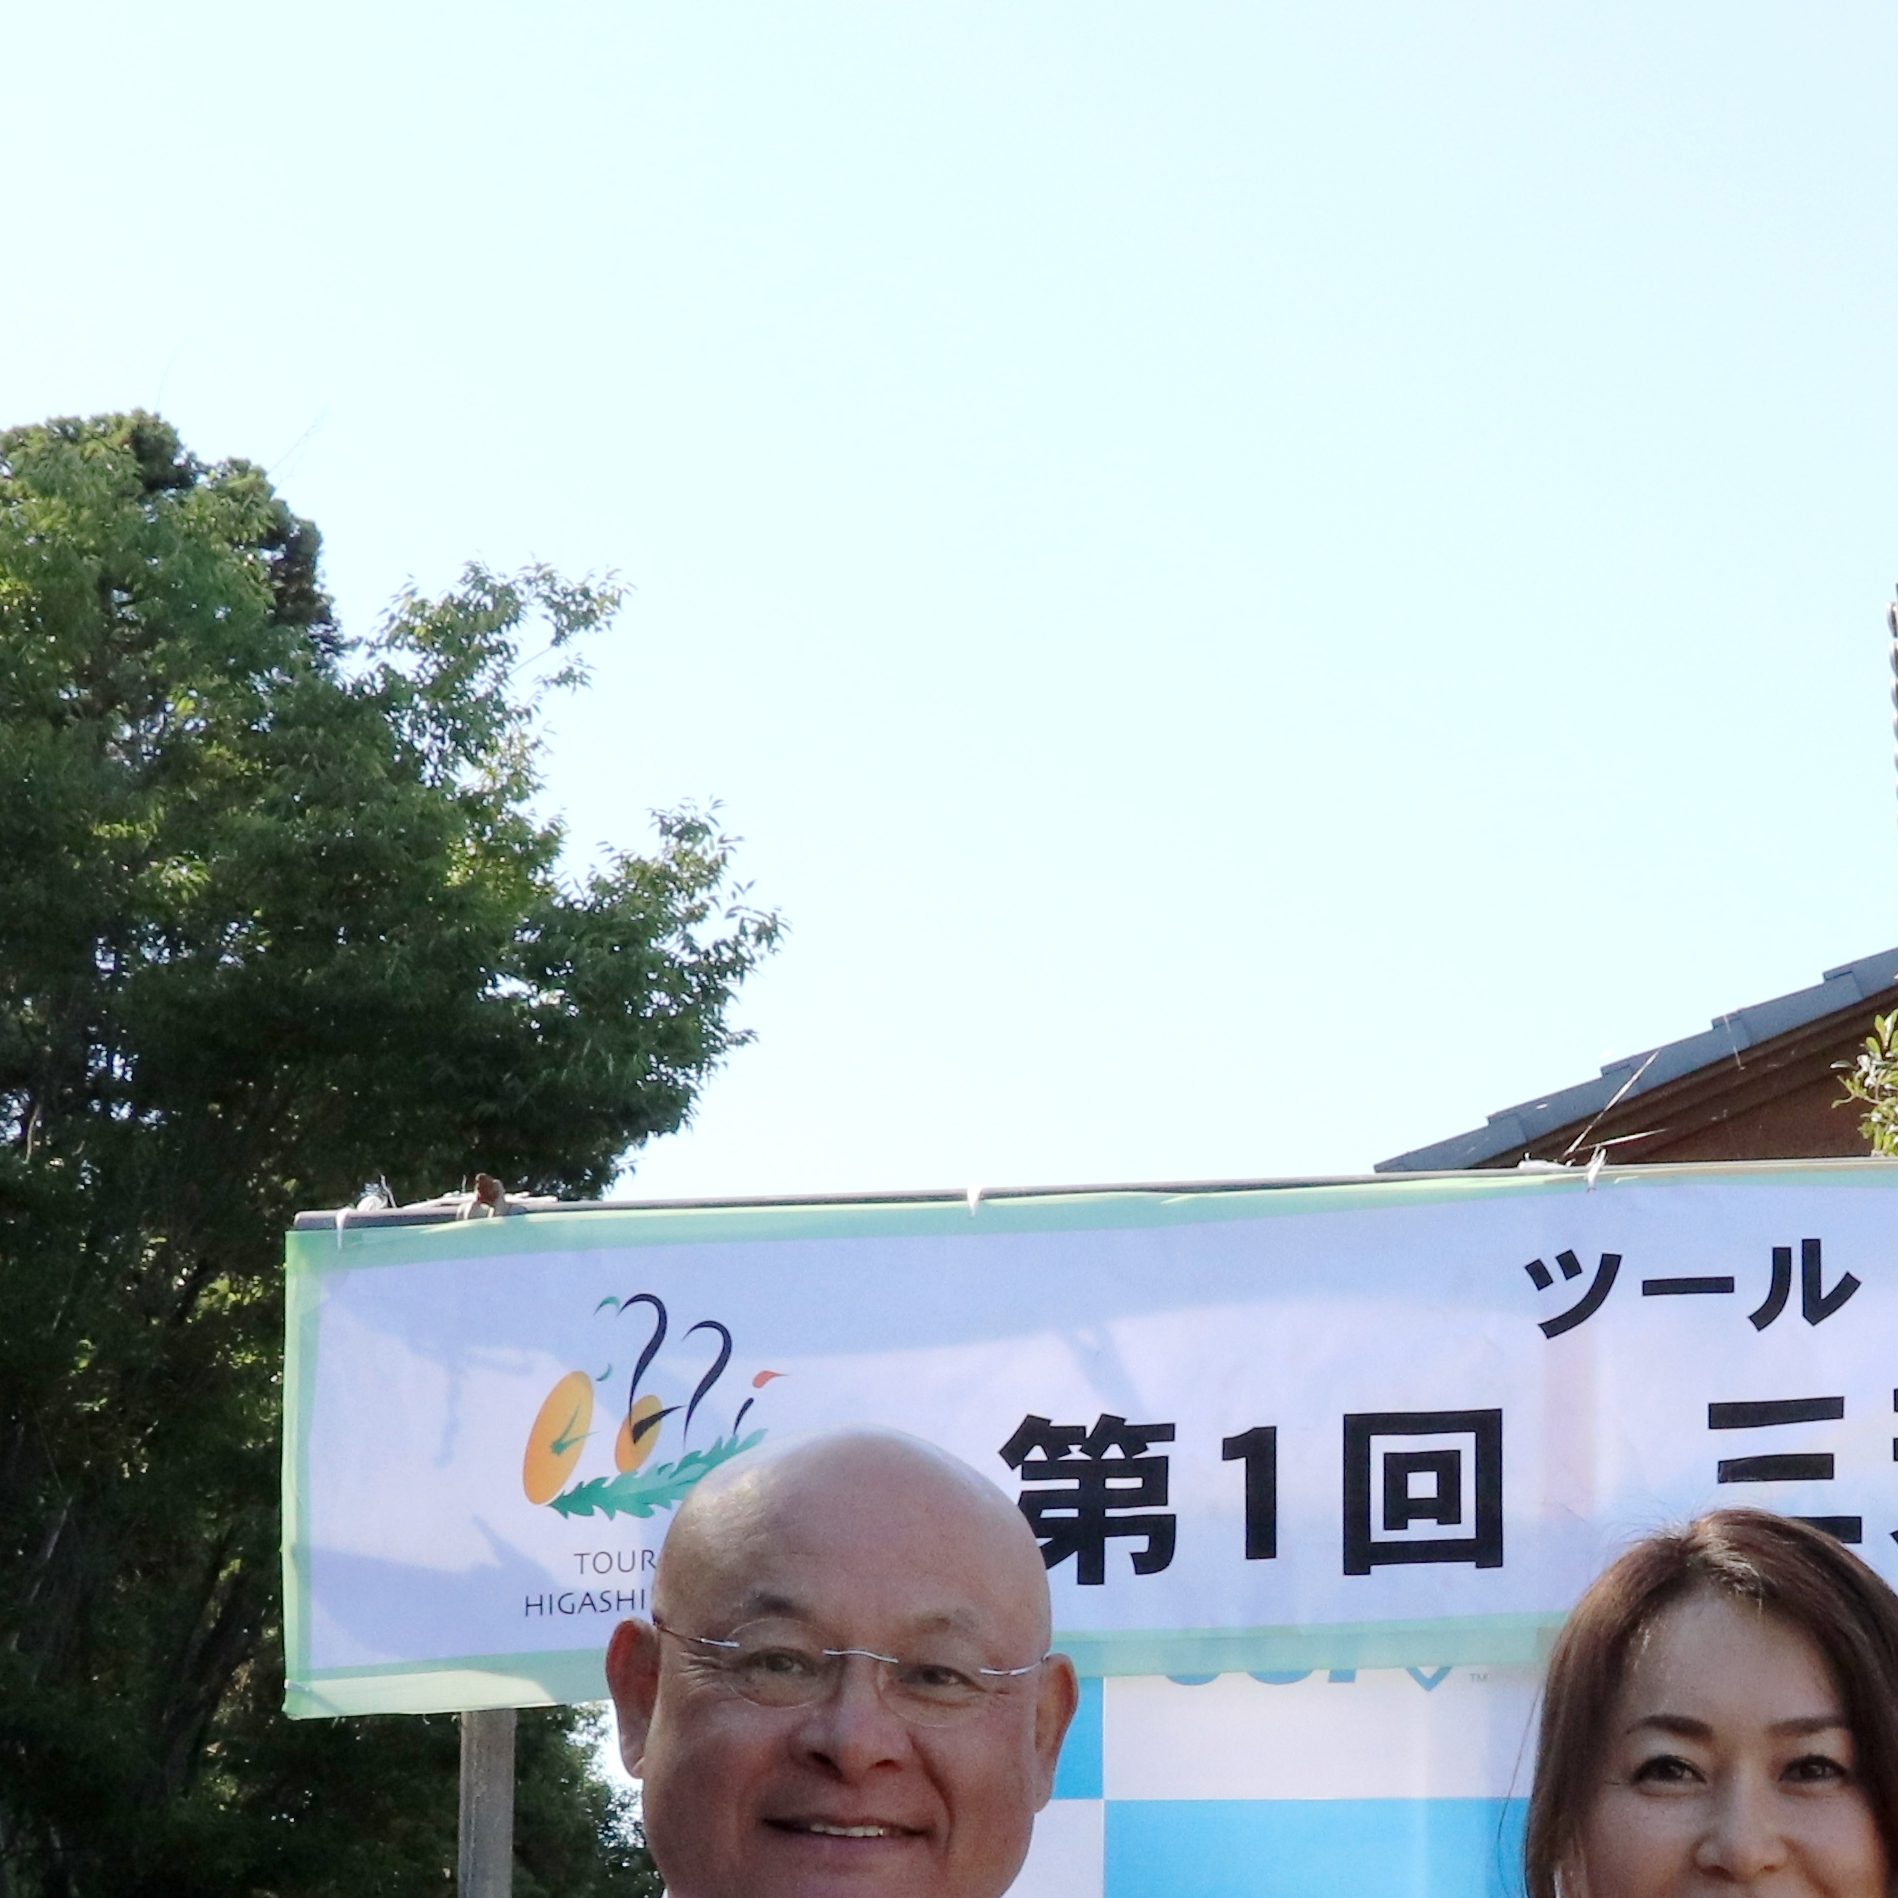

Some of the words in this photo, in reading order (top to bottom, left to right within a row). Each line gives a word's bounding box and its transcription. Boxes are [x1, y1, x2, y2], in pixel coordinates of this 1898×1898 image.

[998, 1407, 1504, 1586] 第1回
[573, 1549, 657, 1575] TOUR
[524, 1588, 646, 1617] HIGASHI
